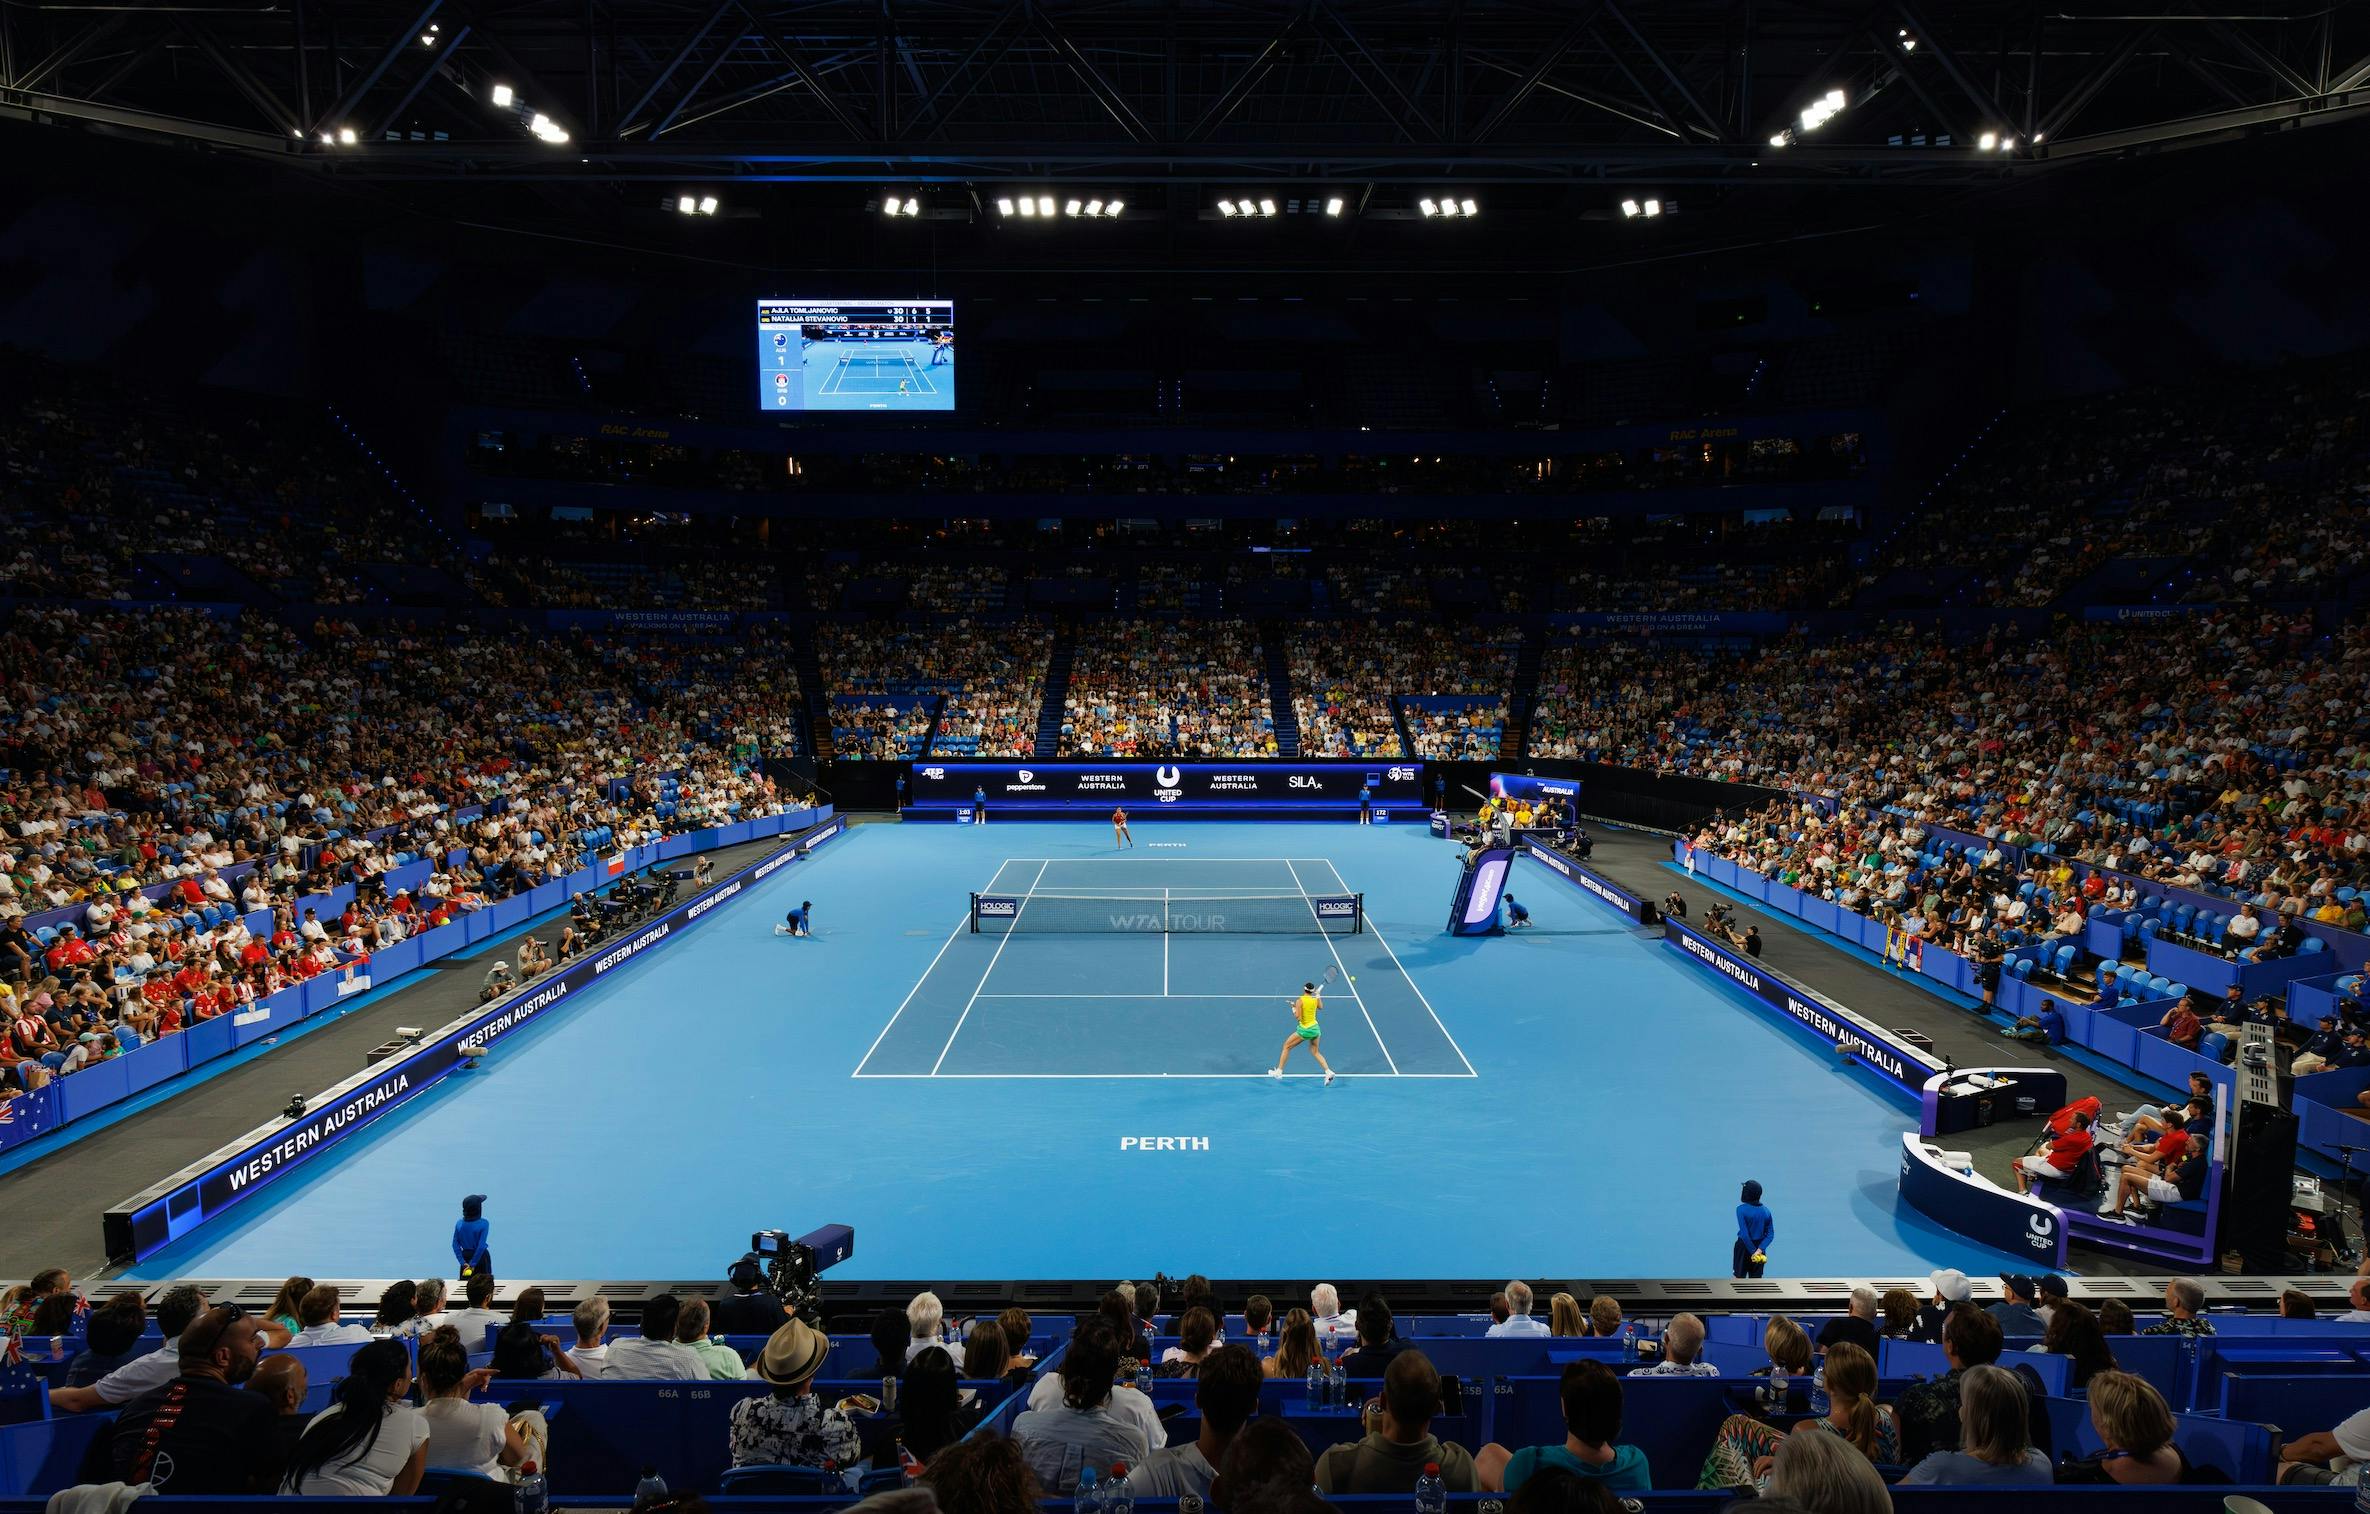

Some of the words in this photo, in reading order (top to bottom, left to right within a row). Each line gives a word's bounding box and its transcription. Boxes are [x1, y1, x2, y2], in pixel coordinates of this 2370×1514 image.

[893, 307, 904, 315] 30
[911, 307, 917, 315] 6
[925, 307, 931, 315] 5
[778, 356, 784, 365] 1
[778, 396, 786, 406] 0
[601, 424, 628, 435] RAC
[632, 427, 670, 439] Arena
[1670, 429, 1696, 440] RAC
[1701, 427, 1736, 439] Arena
[672, 613, 730, 621] AUSTRALIA
[1607, 614, 1656, 622] WESTERN
[1660, 614, 1720, 622] AUSTRALIA
[1007, 784, 1046, 792] pepperstone
[1078, 782, 1126, 790] AUSTRALIA
[1210, 782, 1257, 790] AUSTRALIA
[1542, 786, 1574, 795] AUSTRALIA
[1160, 795, 1176, 803] CUP
[805, 833, 821, 849] WESTERN
[820, 825, 837, 841] AUSTRALIA
[755, 861, 775, 879] WESTERN
[774, 849, 796, 868] AUSTRALIA
[1531, 846, 1549, 864] WESTERN
[1548, 855, 1570, 876] AUSTRALIA
[1580, 874, 1602, 896] WESTERN
[1602, 887, 1630, 912] AUSTRALIA
[687, 896, 714, 920] WESTERN
[714, 880, 741, 903] AUSTRALIA
[980, 902, 1014, 910] HOLOGIC
[1319, 902, 1353, 910] HOLOGIC
[1109, 914, 1161, 929] WTA
[1170, 914, 1225, 931] TOUR
[595, 948, 632, 974] WESTERN
[632, 922, 669, 952] AUSTRALIA
[1682, 934, 1715, 963] WESTERN
[1715, 955, 1759, 991] AUSTRALIA
[457, 1012, 512, 1056] WESTERN
[513, 981, 567, 1023] AUSTRALIA
[1788, 997, 1836, 1038] WESTERN
[1838, 1028, 1904, 1079] AUSTRALIA
[229, 1125, 320, 1191] WESTERN
[324, 1074, 409, 1137] AUSTRALIA
[1120, 1136, 1210, 1151] PERTH
[2025, 1231, 2054, 1247] UNITED
[2031, 1240, 2047, 1249] CUP
[658, 1388, 679, 1399] 66A
[690, 1389, 712, 1400] 66B
[1494, 1384, 1514, 1395] 65A
